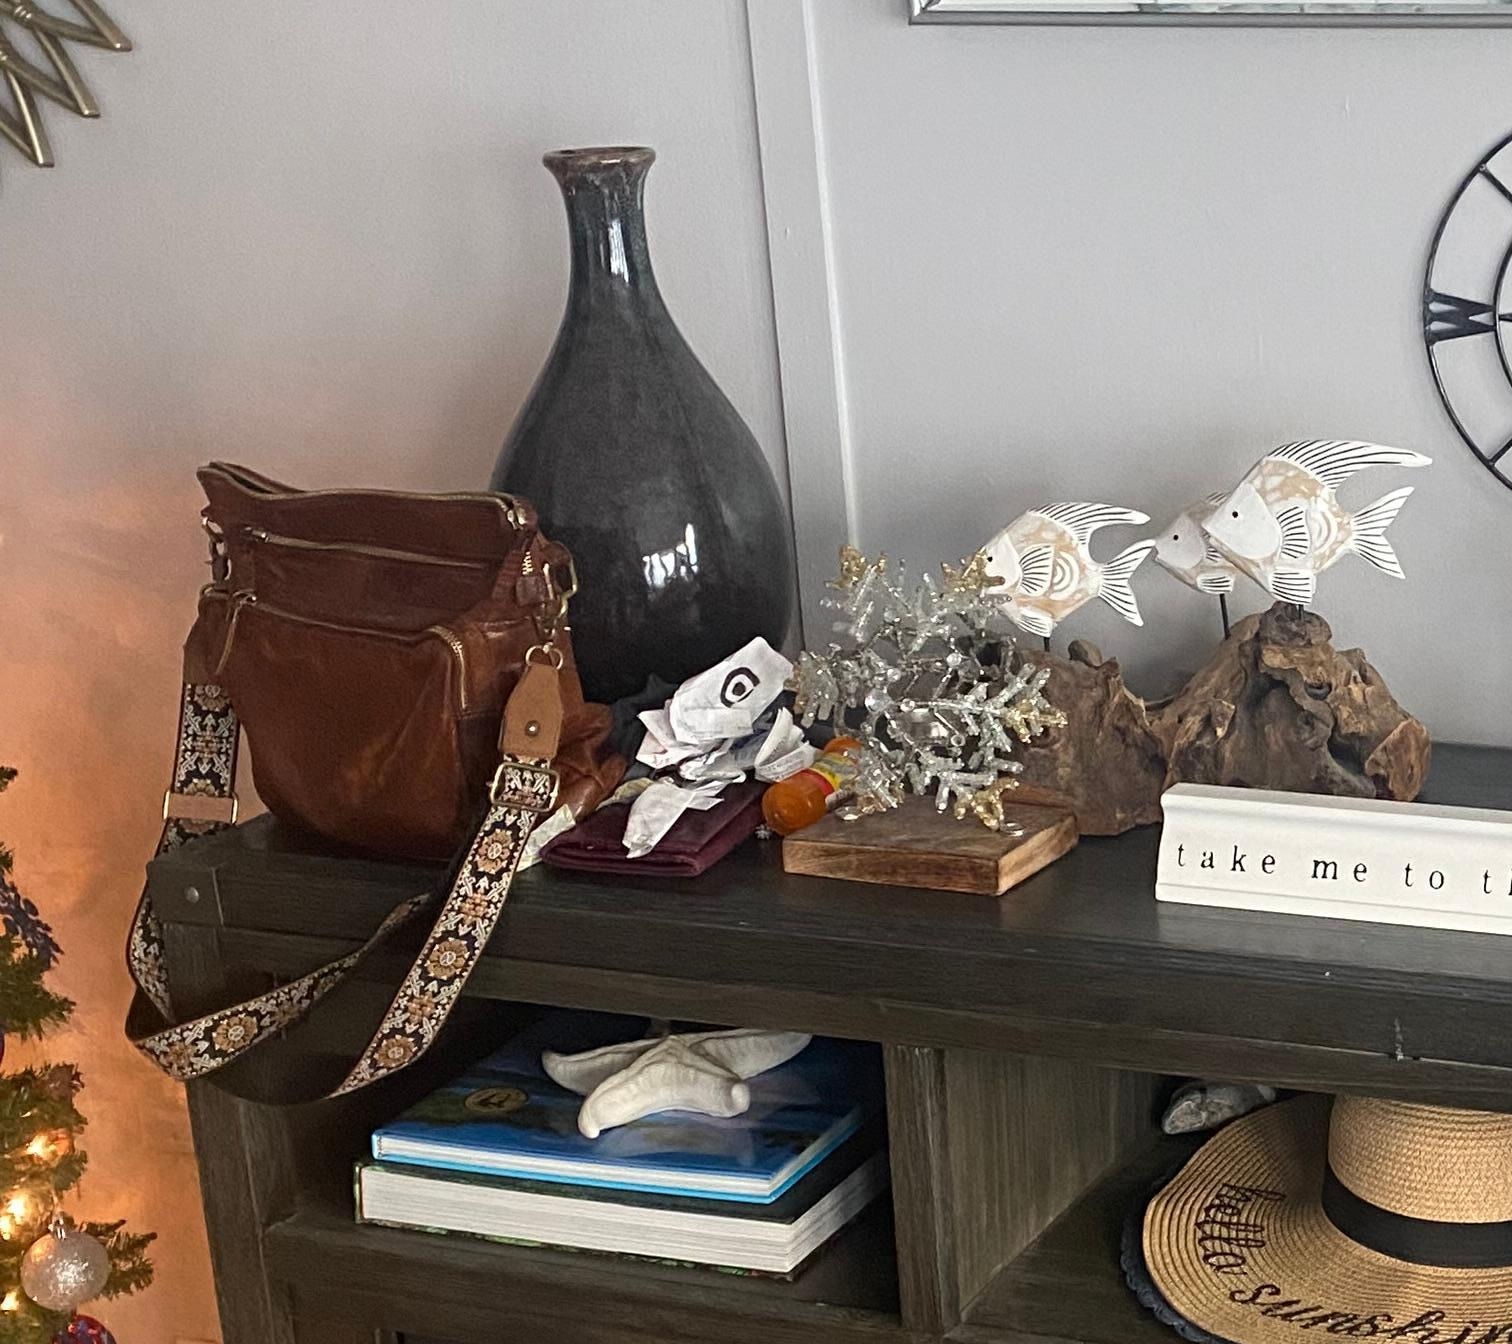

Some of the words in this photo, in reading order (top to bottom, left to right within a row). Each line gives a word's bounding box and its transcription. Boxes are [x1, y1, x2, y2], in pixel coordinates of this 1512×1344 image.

[1424, 288, 1498, 347] W
[1176, 843, 1276, 875] take
[1311, 858, 1368, 883] me
[1404, 862, 1445, 890] to
[1194, 1181, 1287, 1276] hello
